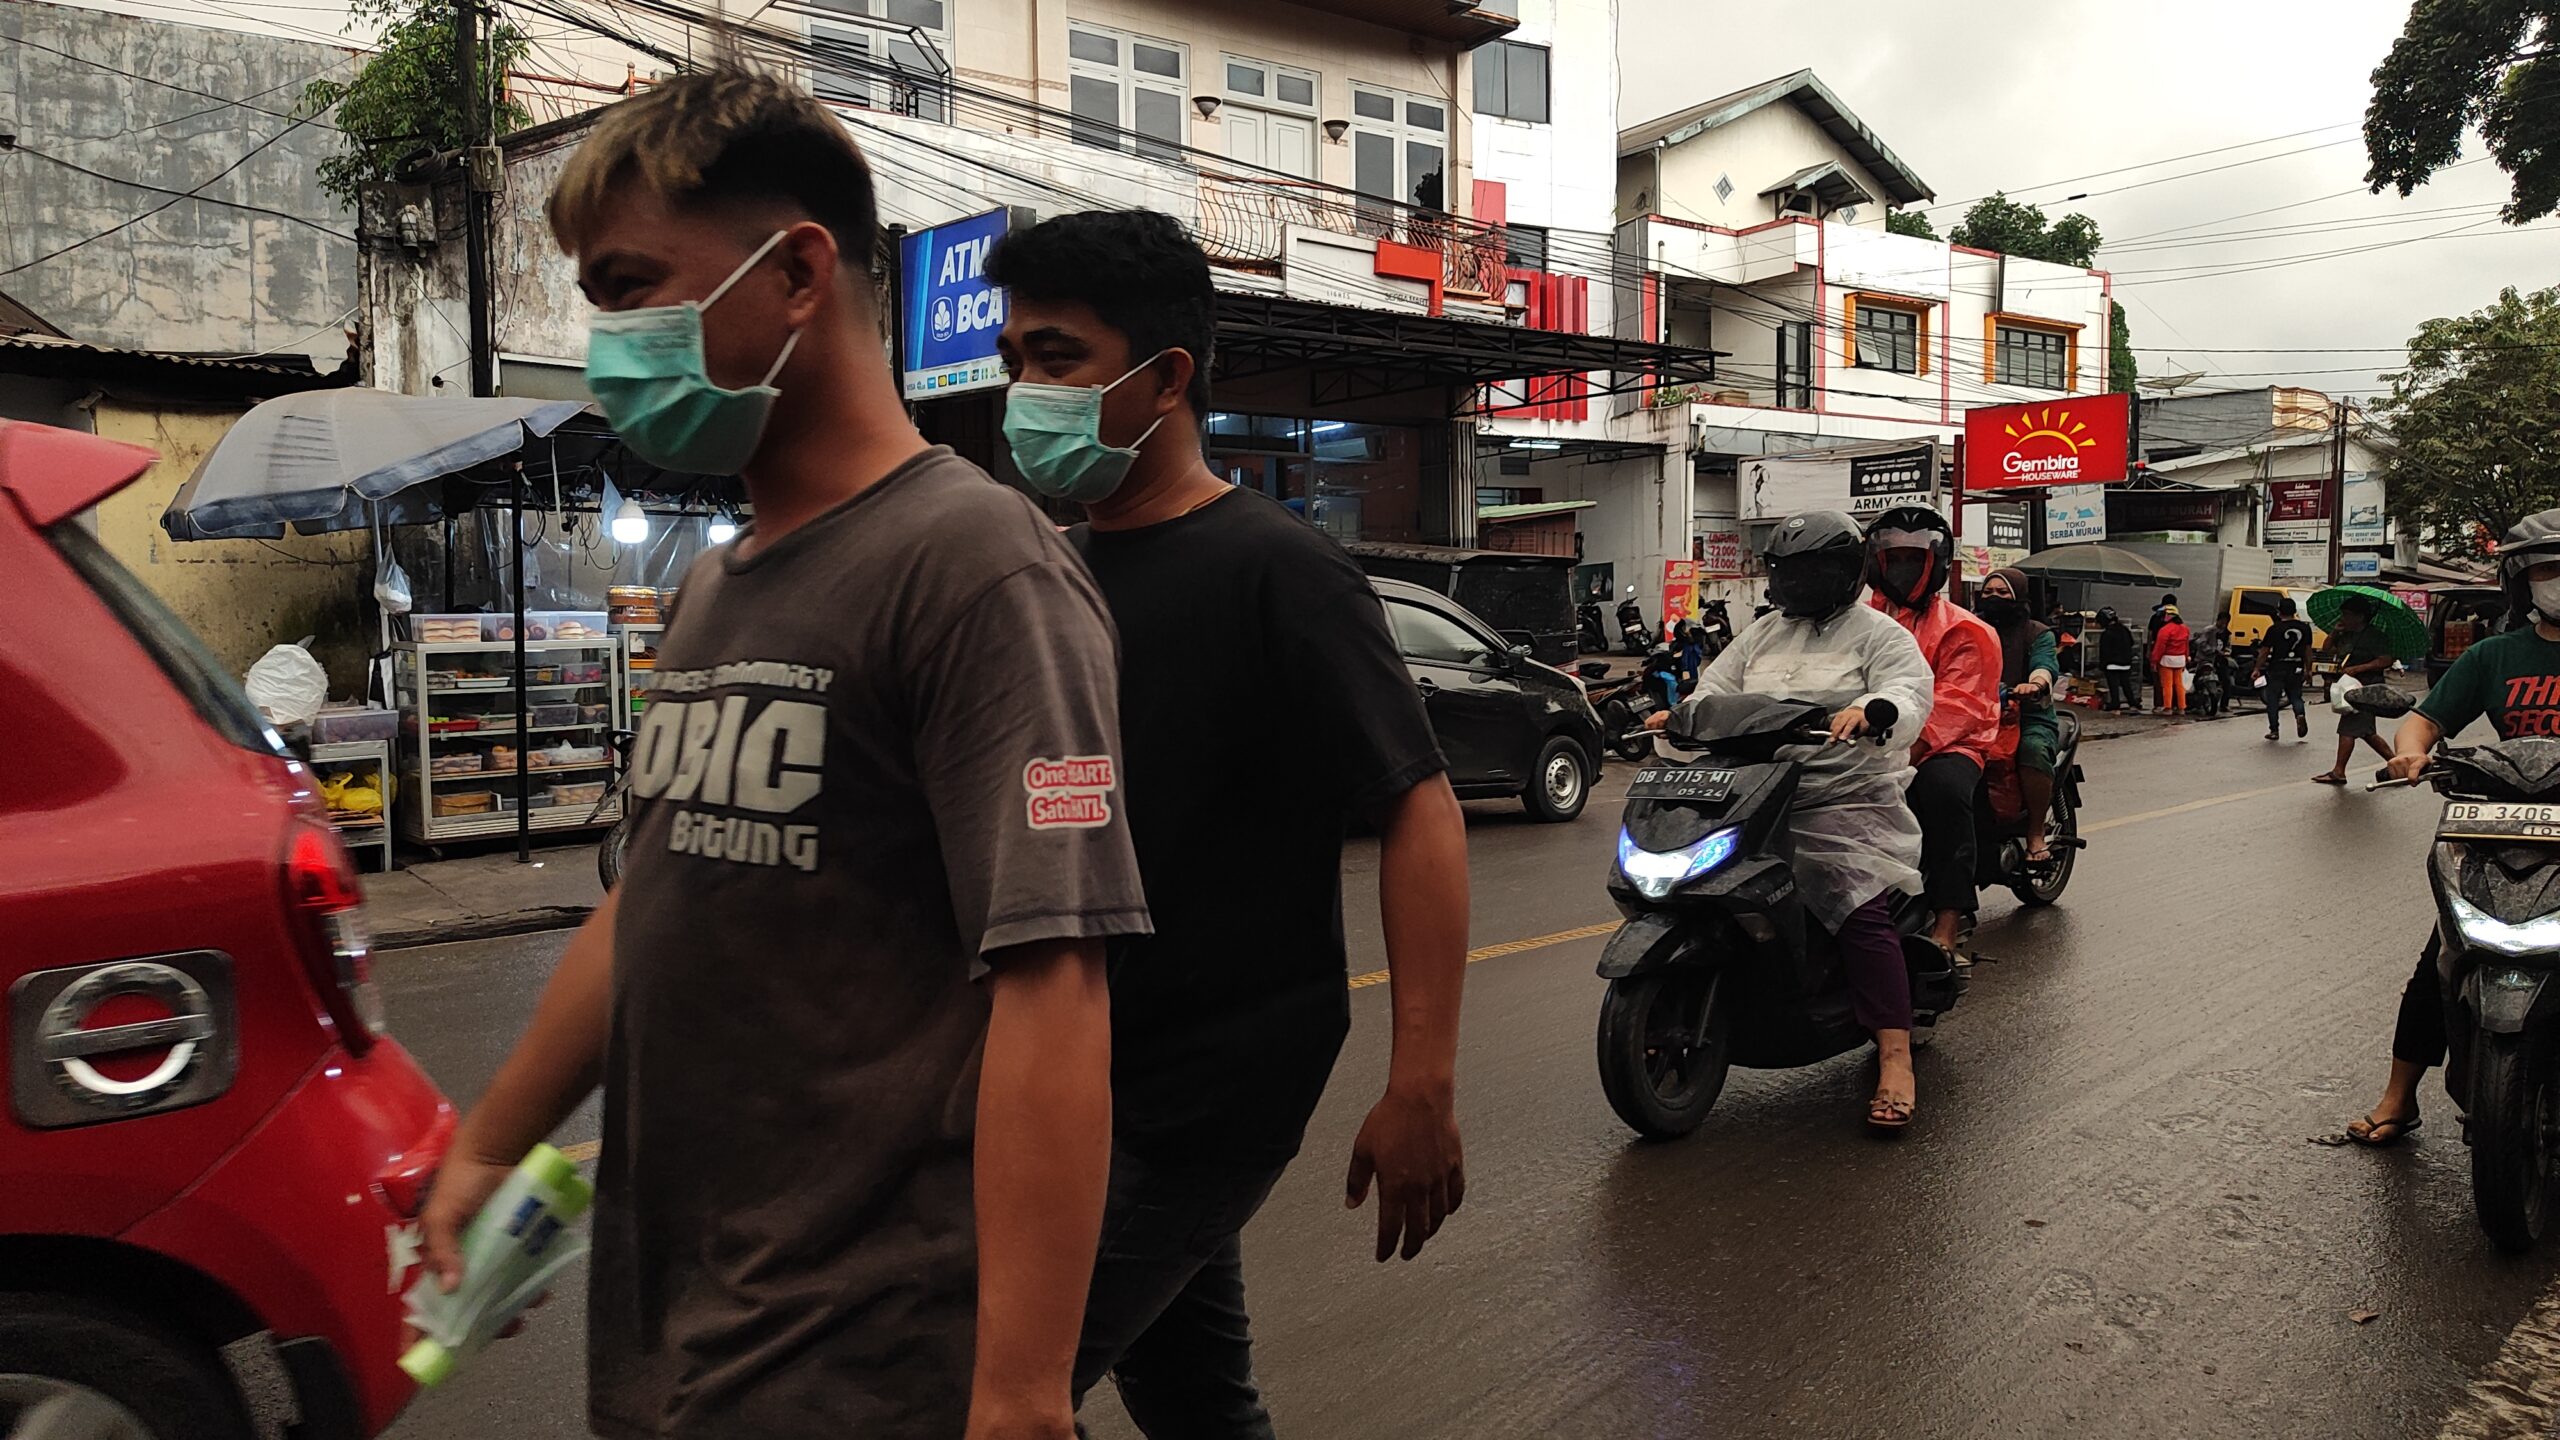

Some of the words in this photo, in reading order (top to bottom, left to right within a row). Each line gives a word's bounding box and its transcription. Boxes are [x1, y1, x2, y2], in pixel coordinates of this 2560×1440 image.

[939, 235, 991, 287] ATM
[956, 287, 1004, 334] BCA
[2003, 452, 2078, 473] Gembira
[2021, 470, 2078, 482] HOUSEWARE
[1854, 497, 1892, 510] ARMY
[2065, 521, 2086, 529] TOKO
[2050, 529, 2074, 540] SERBA
[2075, 526, 2103, 537] MURAH
[1635, 771, 1657, 784] DB
[1664, 770, 1706, 784] 6715
[1709, 771, 1734, 784] MT
[2452, 806, 2480, 819] DB
[2495, 806, 2552, 821] 3406
